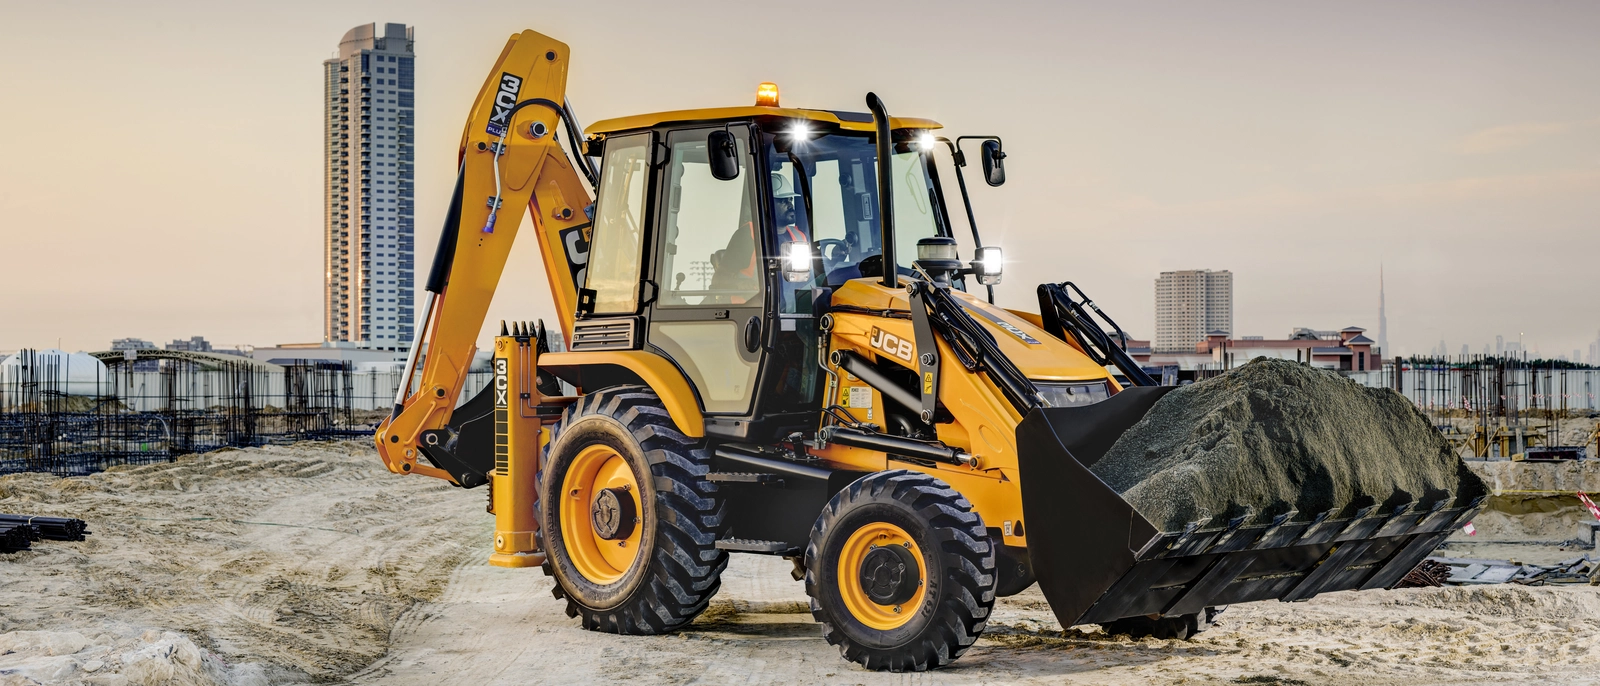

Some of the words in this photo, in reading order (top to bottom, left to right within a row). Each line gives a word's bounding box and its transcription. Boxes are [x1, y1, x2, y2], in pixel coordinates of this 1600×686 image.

[490, 74, 520, 123] 3CX
[487, 126, 502, 136] PLU
[871, 330, 913, 361] JCB
[496, 359, 507, 405] 3CX
